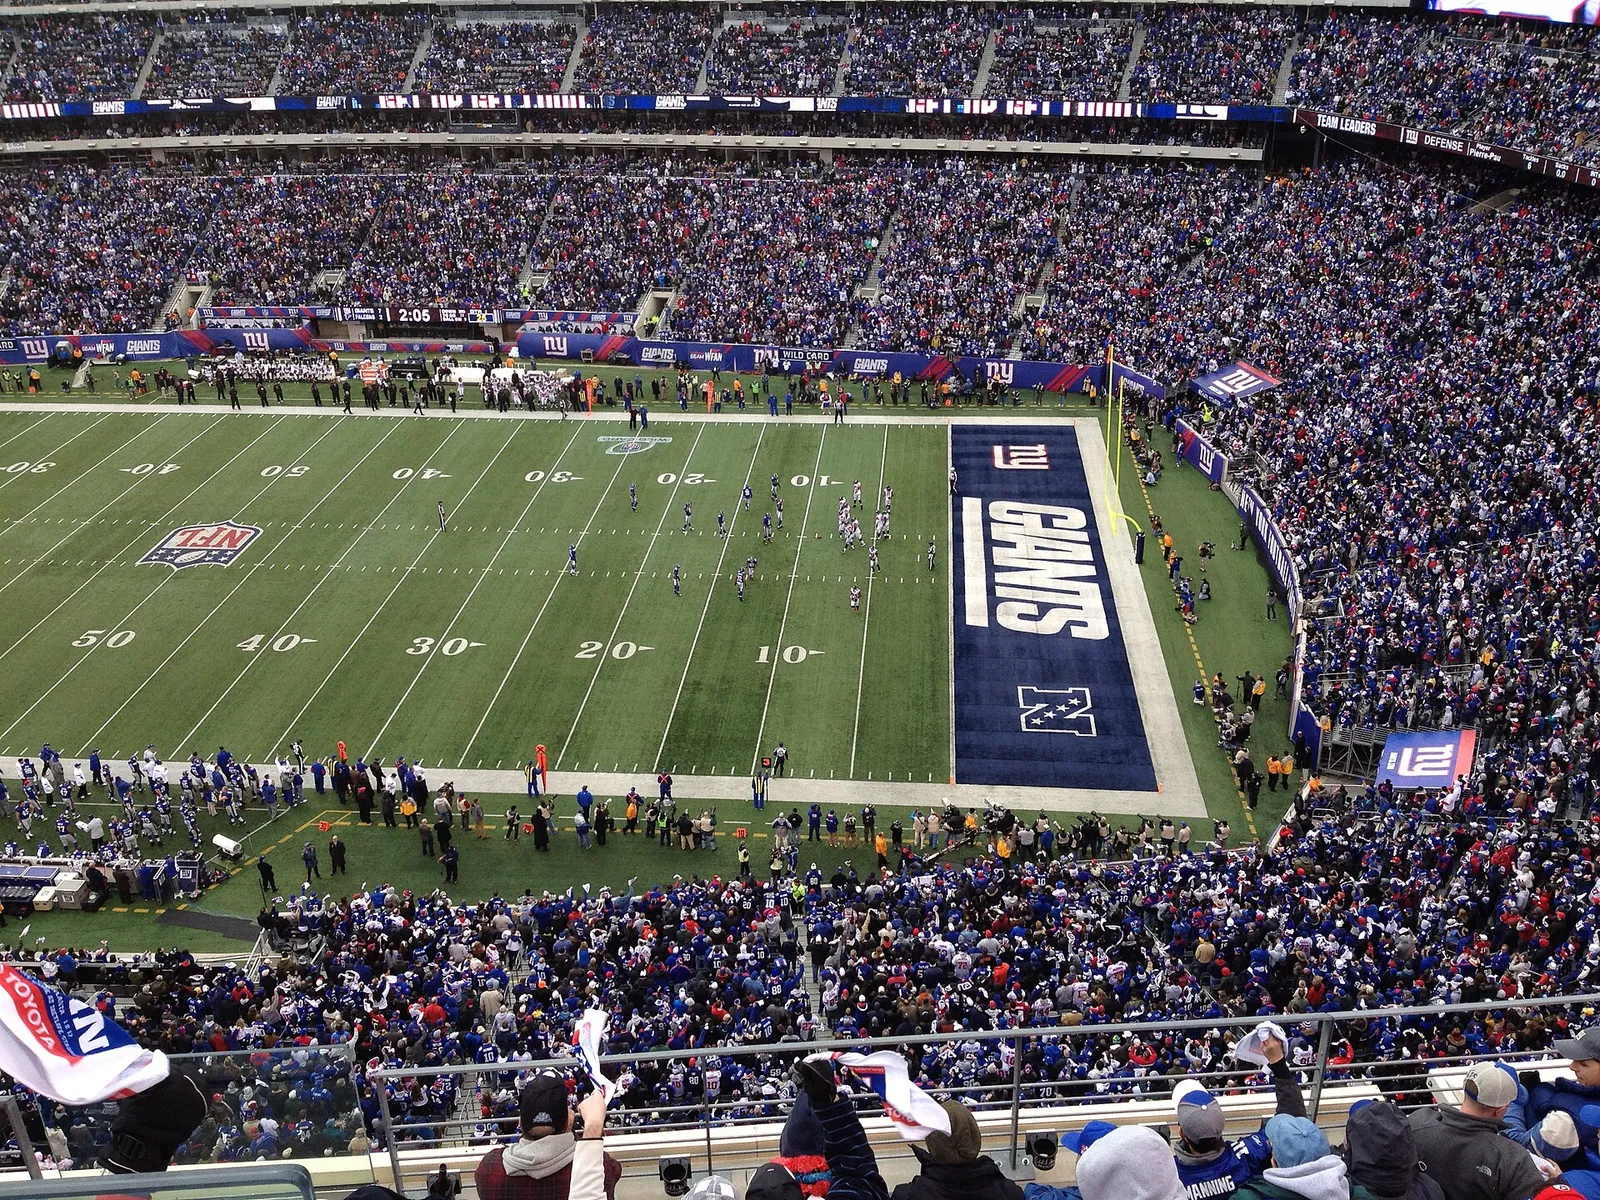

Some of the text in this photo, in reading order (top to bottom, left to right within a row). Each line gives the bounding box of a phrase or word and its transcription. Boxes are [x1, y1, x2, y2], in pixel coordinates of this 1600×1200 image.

[92, 101, 125, 113] GIANTS
[1317, 113, 1377, 136] TEAM LEADERS
[1424, 134, 1464, 152] DEFENSE
[1475, 143, 1491, 151] Player
[1555, 170, 1566, 179] 0.0
[399, 308, 430, 322] 2:05
[96, 340, 114, 352] WFAN
[127, 339, 161, 351] GIANTS
[641, 347, 674, 359] GIANTS
[704, 349, 723, 362] WFAN
[782, 350, 830, 361] WILD CARD
[854, 358, 889, 370] GIANTS
[6, 461, 57, 474] 30
[128, 463, 181, 475] 40
[260, 465, 311, 477] 50
[391, 467, 442, 481] 40
[524, 470, 573, 484] 30
[655, 471, 705, 485] 20
[790, 474, 832, 488] 10
[176, 527, 253, 549] NFL
[987, 500, 1110, 640] GIANTS
[71, 630, 136, 648] 50
[236, 634, 302, 652] 40
[405, 636, 470, 658] 30
[573, 641, 638, 661] 20
[754, 644, 810, 665] 10
[736, 827, 746, 838] 10
[1037, 877, 1046, 886] 10
[765, 898, 775, 909] 10
[780, 897, 789, 907] 10
[757, 950, 765, 960] 10
[713, 960, 722, 970] 10
[957, 961, 968, 970] 72
[537, 971, 546, 980] 10
[771, 985, 782, 996] 88
[5, 972, 56, 1050] TOYOTA
[483, 1051, 494, 1063] 10
[688, 1075, 699, 1085] 80
[707, 1081, 718, 1090] 10
[1039, 1087, 1051, 1098] 70
[1185, 1175, 1236, 1200] MANNING
